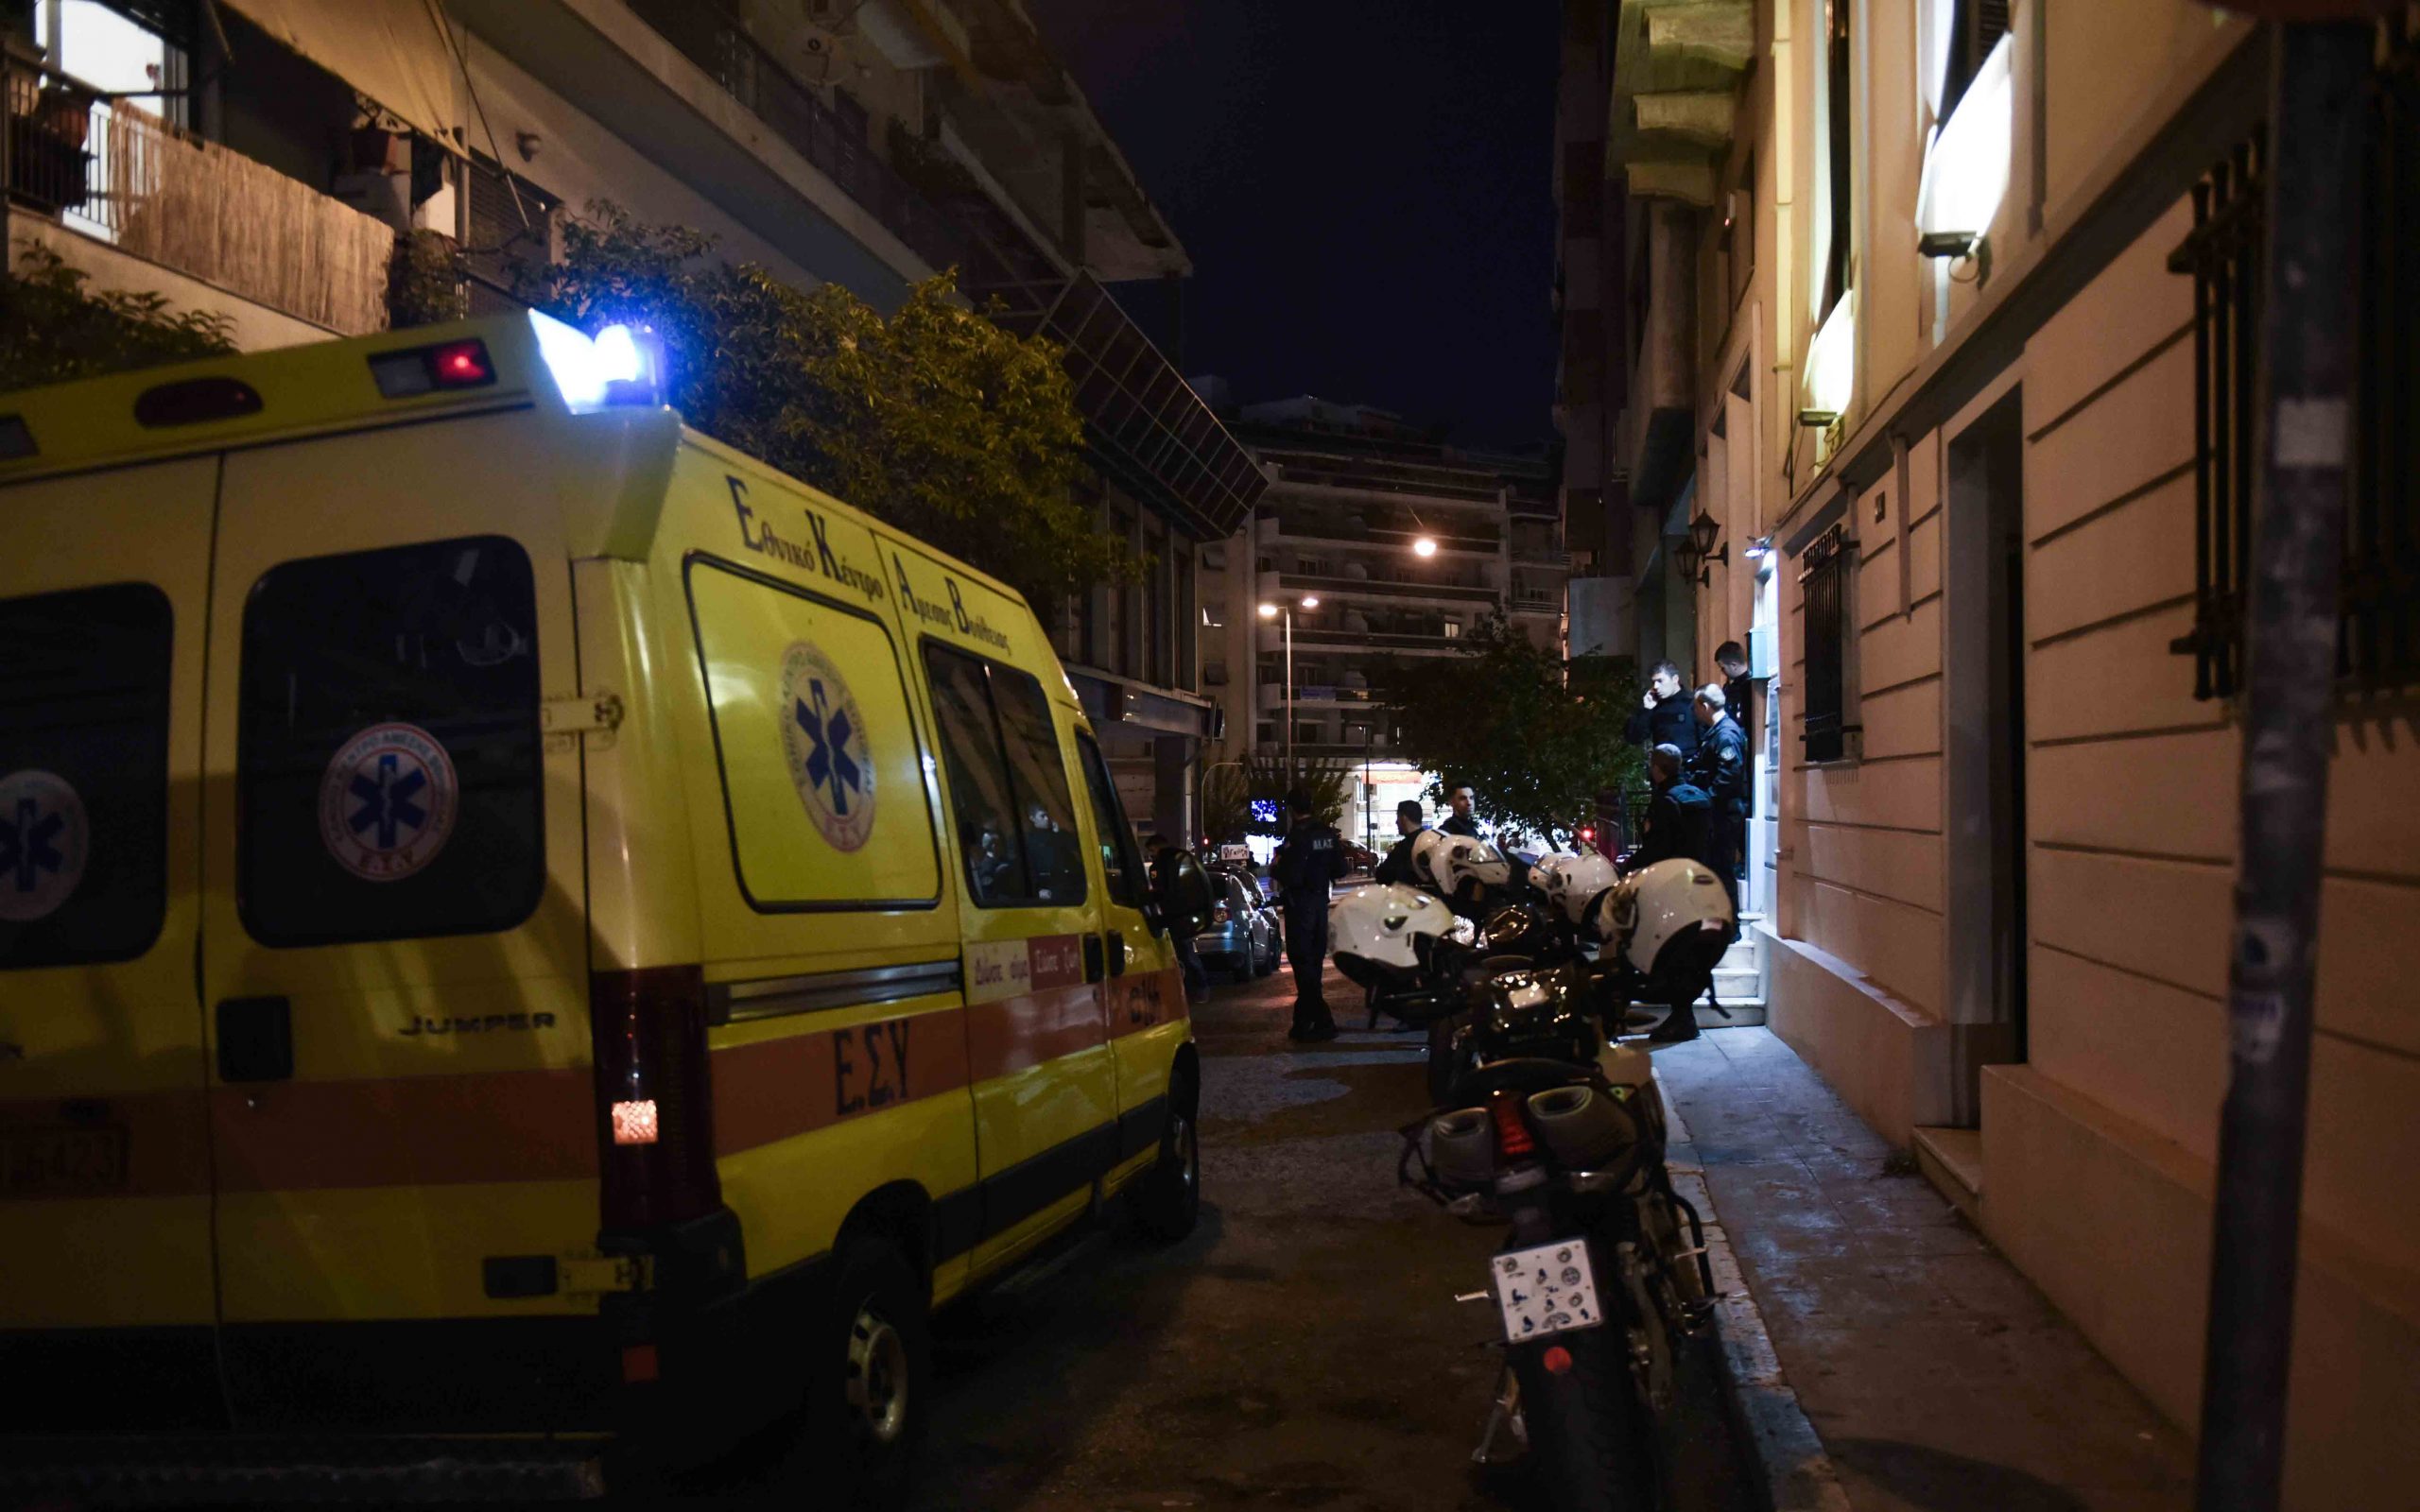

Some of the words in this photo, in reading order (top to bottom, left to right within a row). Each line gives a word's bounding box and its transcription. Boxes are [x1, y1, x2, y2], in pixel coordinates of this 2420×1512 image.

[725, 473, 816, 573] Εθνικό
[804, 508, 884, 603] Κέντρο
[398, 1011, 556, 1037] JUMPER
